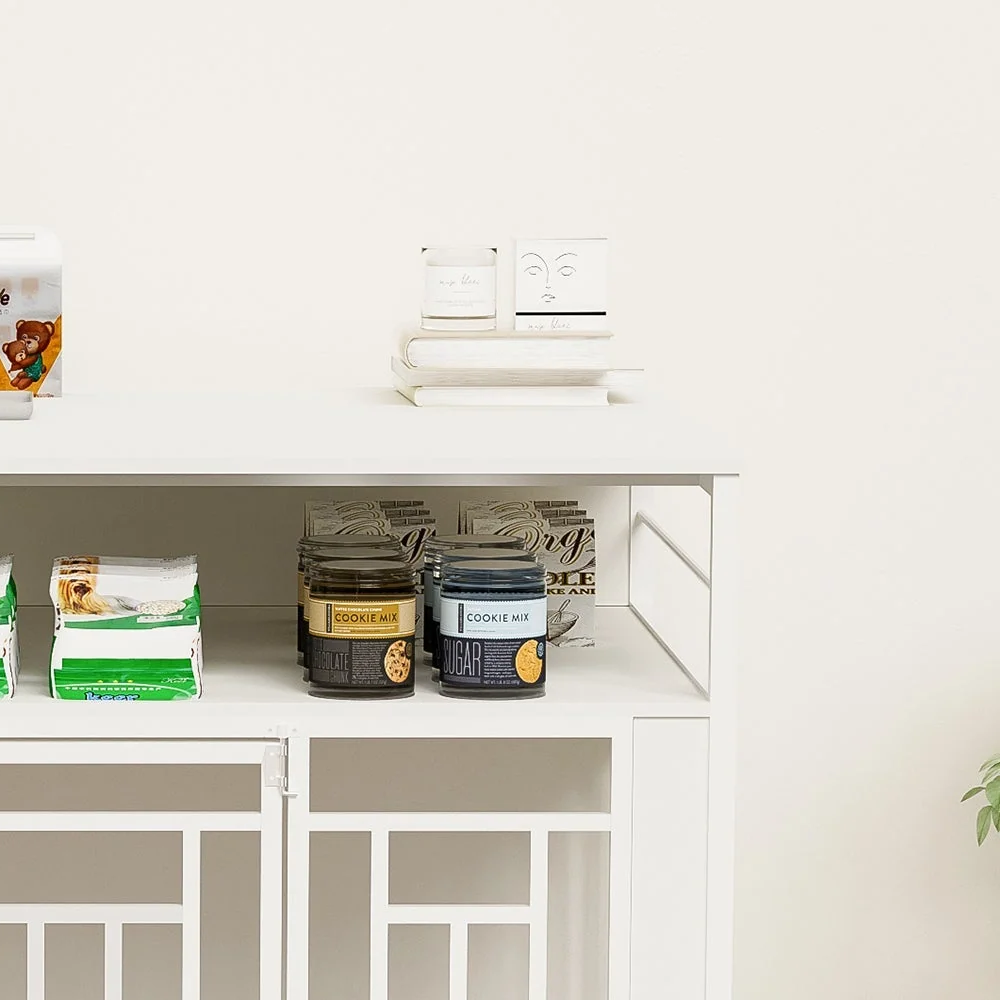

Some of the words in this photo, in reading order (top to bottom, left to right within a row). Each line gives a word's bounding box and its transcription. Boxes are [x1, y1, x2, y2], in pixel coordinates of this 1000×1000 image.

[546, 572, 595, 586] OLE
[335, 613, 376, 622] COOKIE
[380, 613, 397, 622] MIX
[467, 613, 508, 622] COOKIE
[511, 613, 529, 622] MIX
[443, 638, 481, 676] SUGAR
